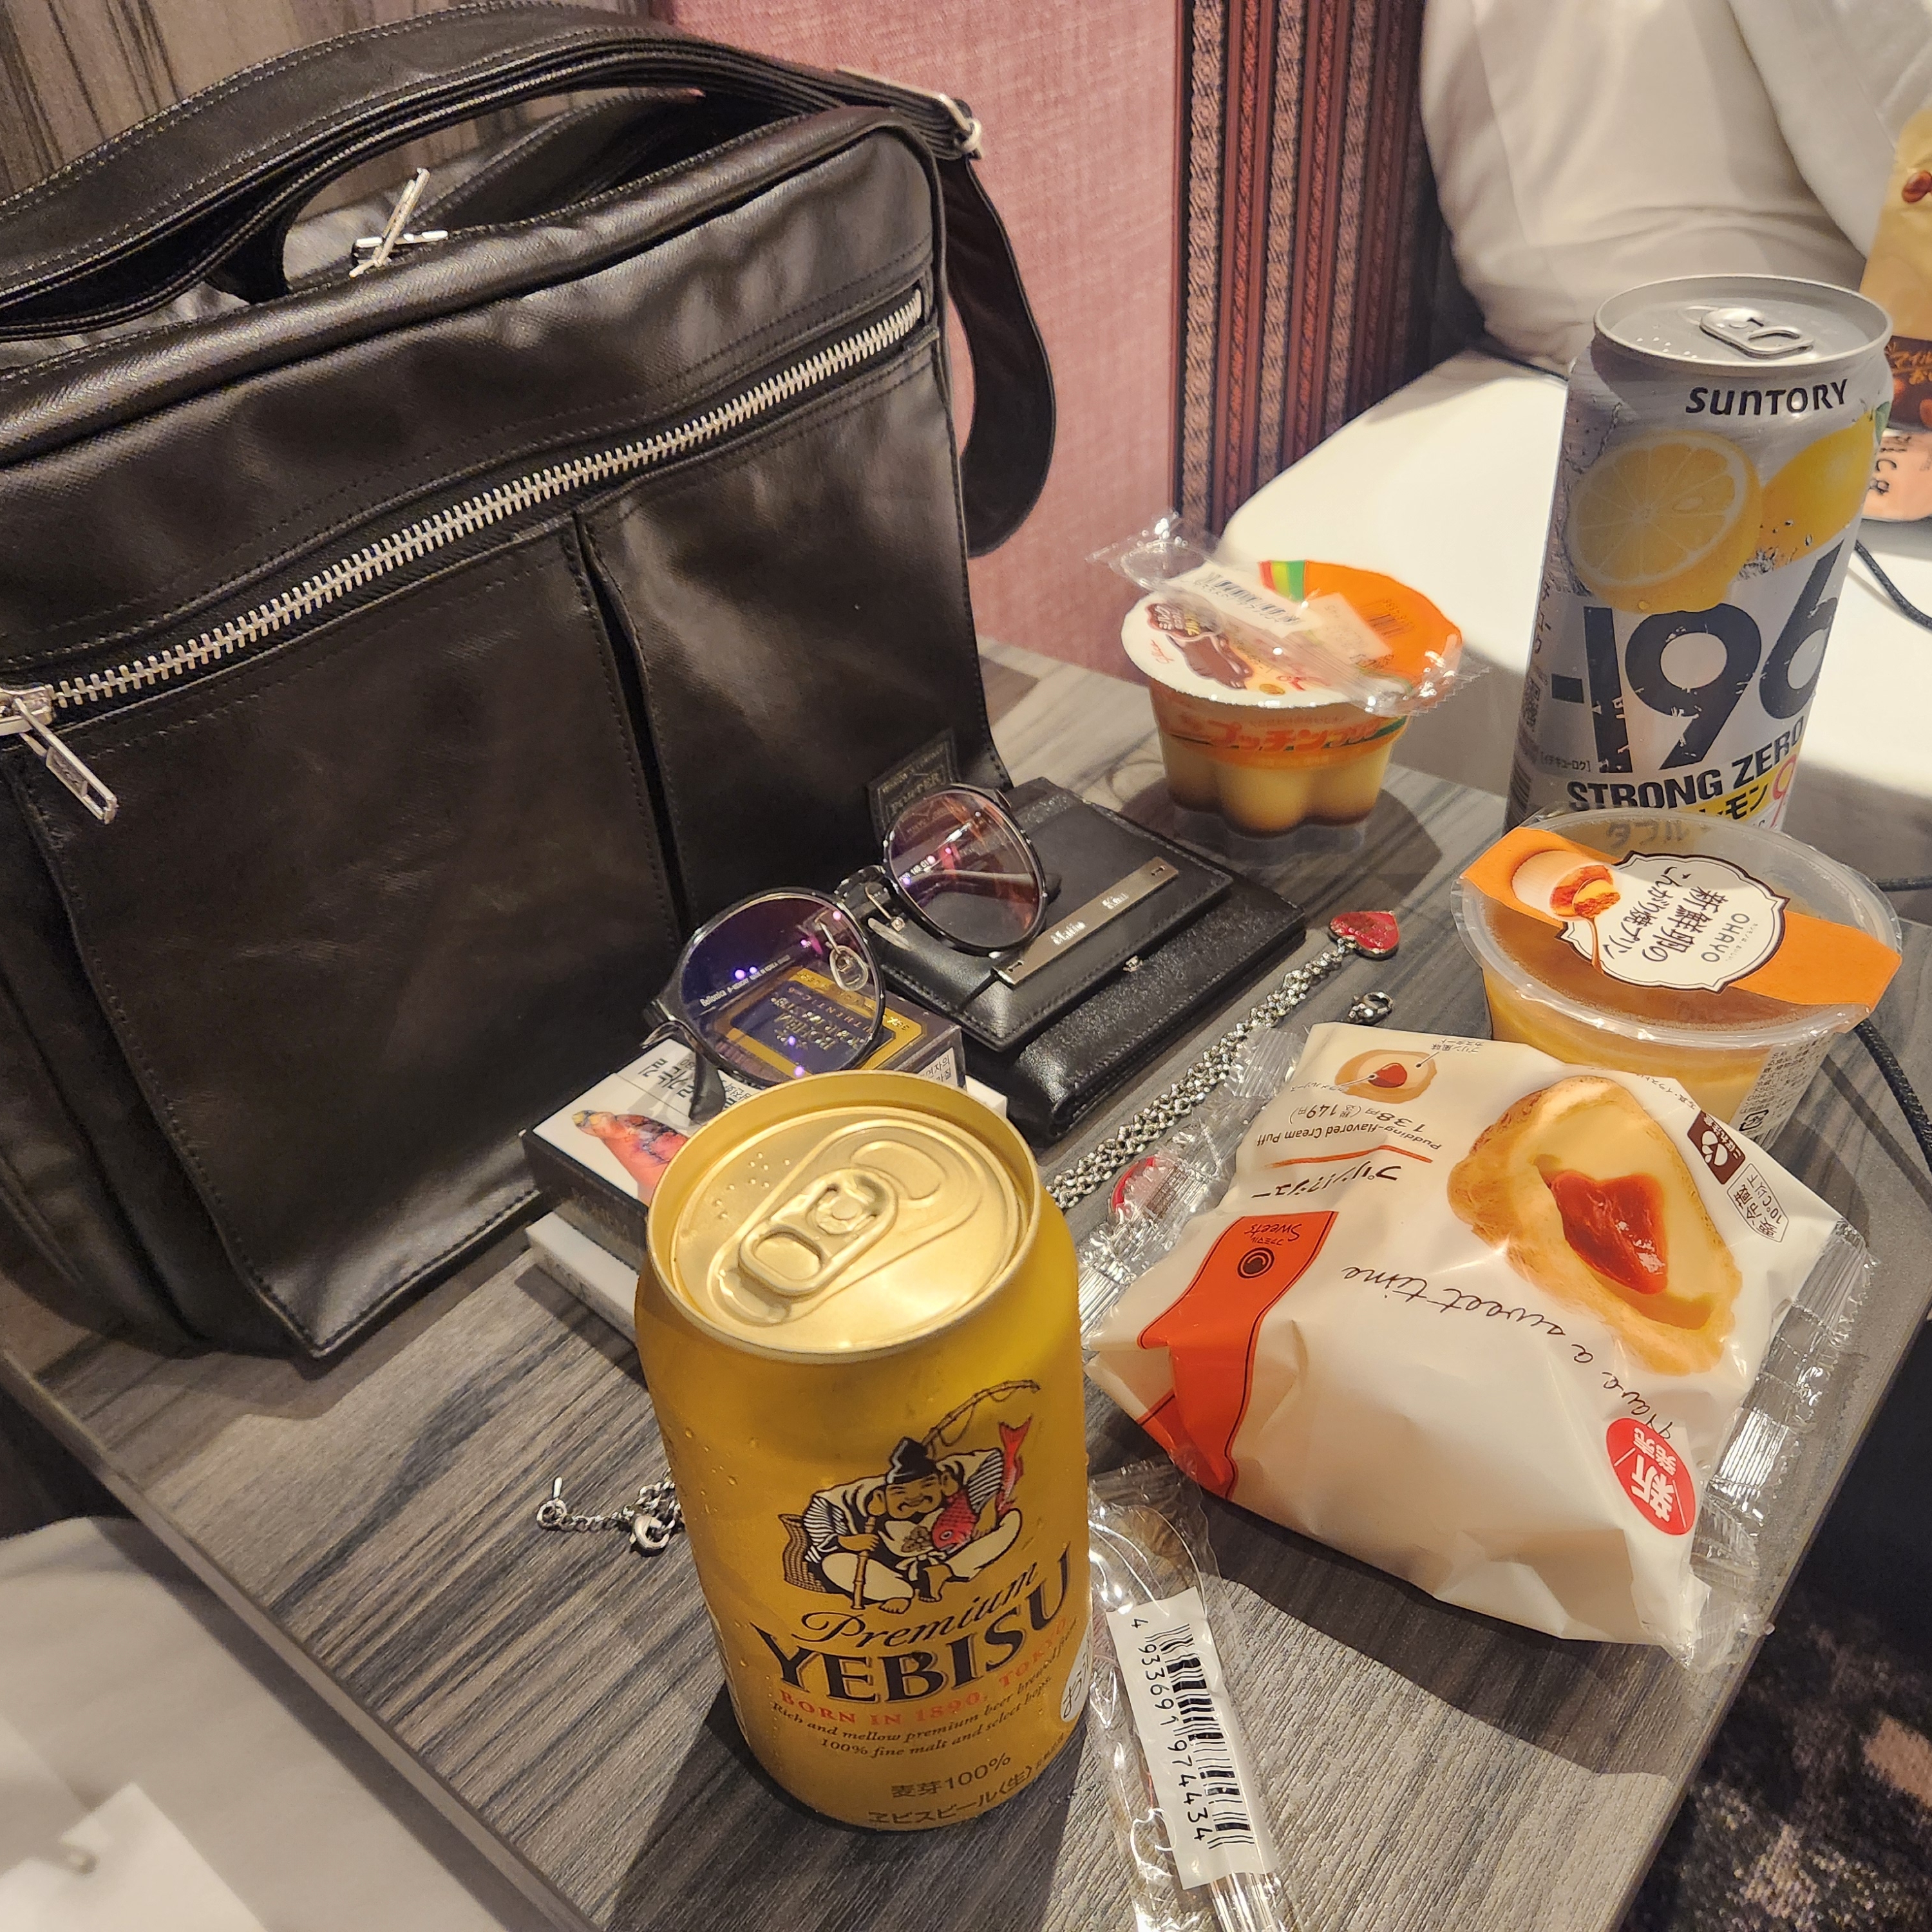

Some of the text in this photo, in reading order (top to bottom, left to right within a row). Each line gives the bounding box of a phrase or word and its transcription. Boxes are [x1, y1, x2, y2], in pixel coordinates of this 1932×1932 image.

[1685, 378, 1848, 416] SUNTORY
[1551, 539, 1844, 775] -196
[1567, 716, 1805, 813] STRONG ZERO
[1642, 885, 1728, 962] 新鮮卵の
[1700, 912, 1750, 964] OHAYO
[1256, 1122, 1442, 1151] Pudding-flavored Cream Puff
[1244, 1223, 1302, 1242] Sweets
[1732, 1184, 1777, 1238] 要冷蔵
[1341, 1265, 1430, 1302] time
[1441, 1287, 1566, 1336] sweet
[1571, 1343, 1594, 1364] a
[749, 1540, 1072, 1704] YEBISU
[790, 1562, 1037, 1648] Premium
[779, 1689, 856, 1723] BORN
[869, 1713, 902, 1726] IN
[998, 1616, 1066, 1688] TOKYO
[773, 1701, 804, 1724] Rich
[806, 1721, 838, 1736] and
[842, 1725, 901, 1742] mellow
[904, 1712, 980, 1743] premium
[983, 1692, 1014, 1716] beer
[820, 1738, 869, 1756] 100%
[870, 1746, 905, 1759] fine
[909, 1739, 947, 1756] malt
[951, 1727, 983, 1745] and
[984, 1703, 1021, 1731] select
[1137, 1643, 1180, 1726] 933691
[1166, 1740, 1215, 1842] 974434
[890, 1752, 1012, 1799] 麦芽100%
